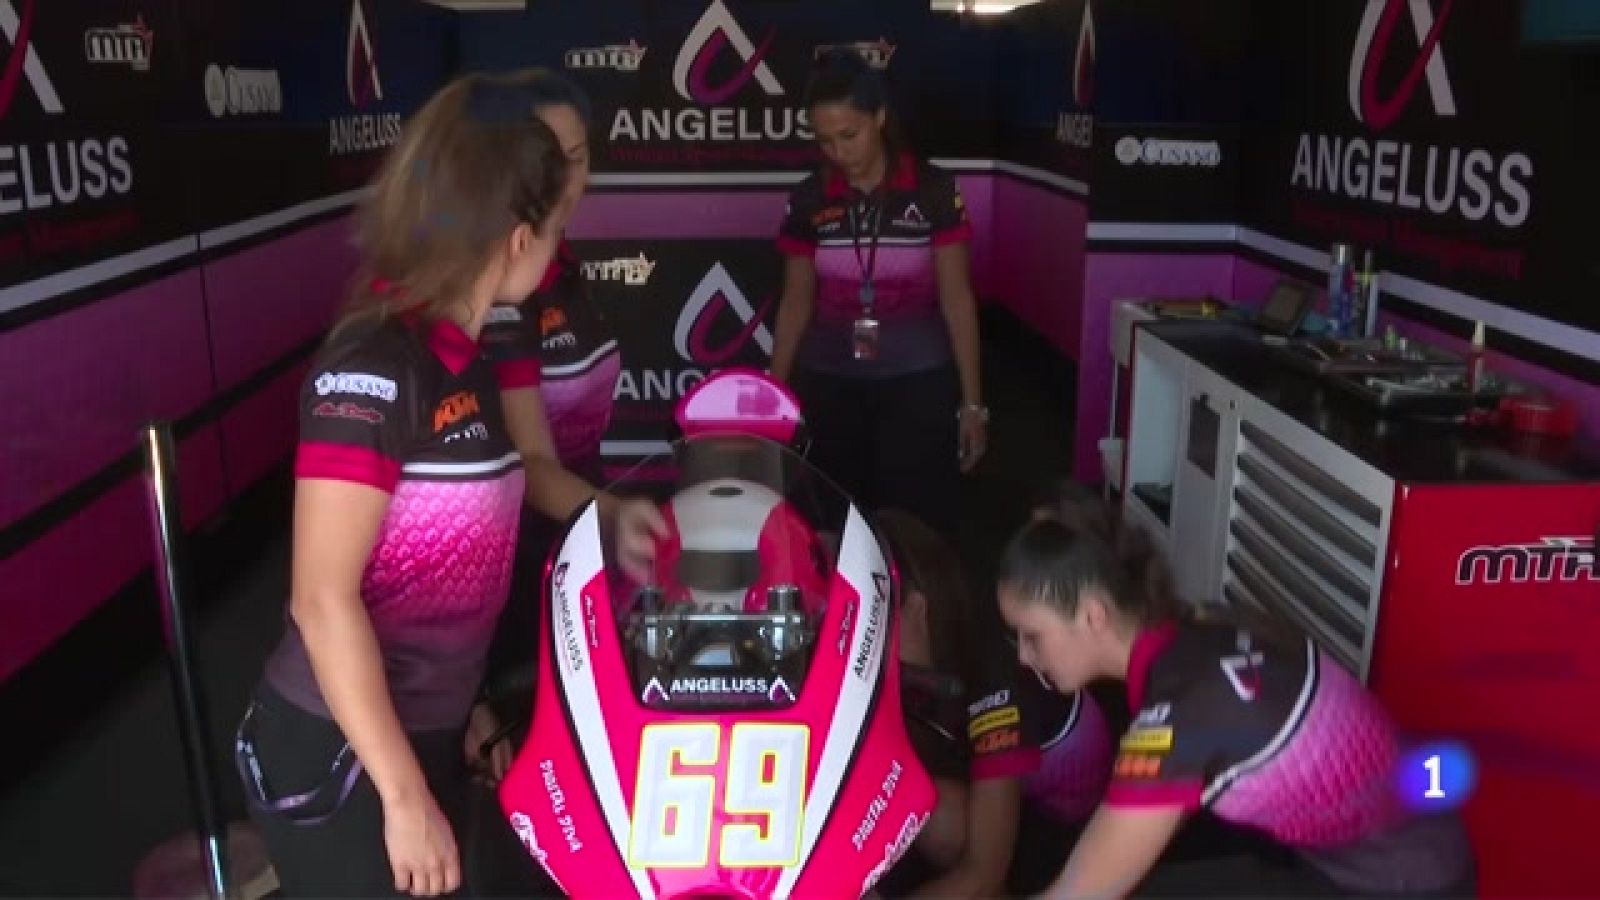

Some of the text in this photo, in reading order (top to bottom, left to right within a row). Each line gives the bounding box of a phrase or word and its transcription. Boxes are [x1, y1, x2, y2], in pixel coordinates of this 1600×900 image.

[609, 107, 817, 142] ANGELUS
[1291, 133, 1533, 228] ANGELUSS
[670, 677, 768, 695] ANGELUSS
[629, 721, 811, 870] 69
